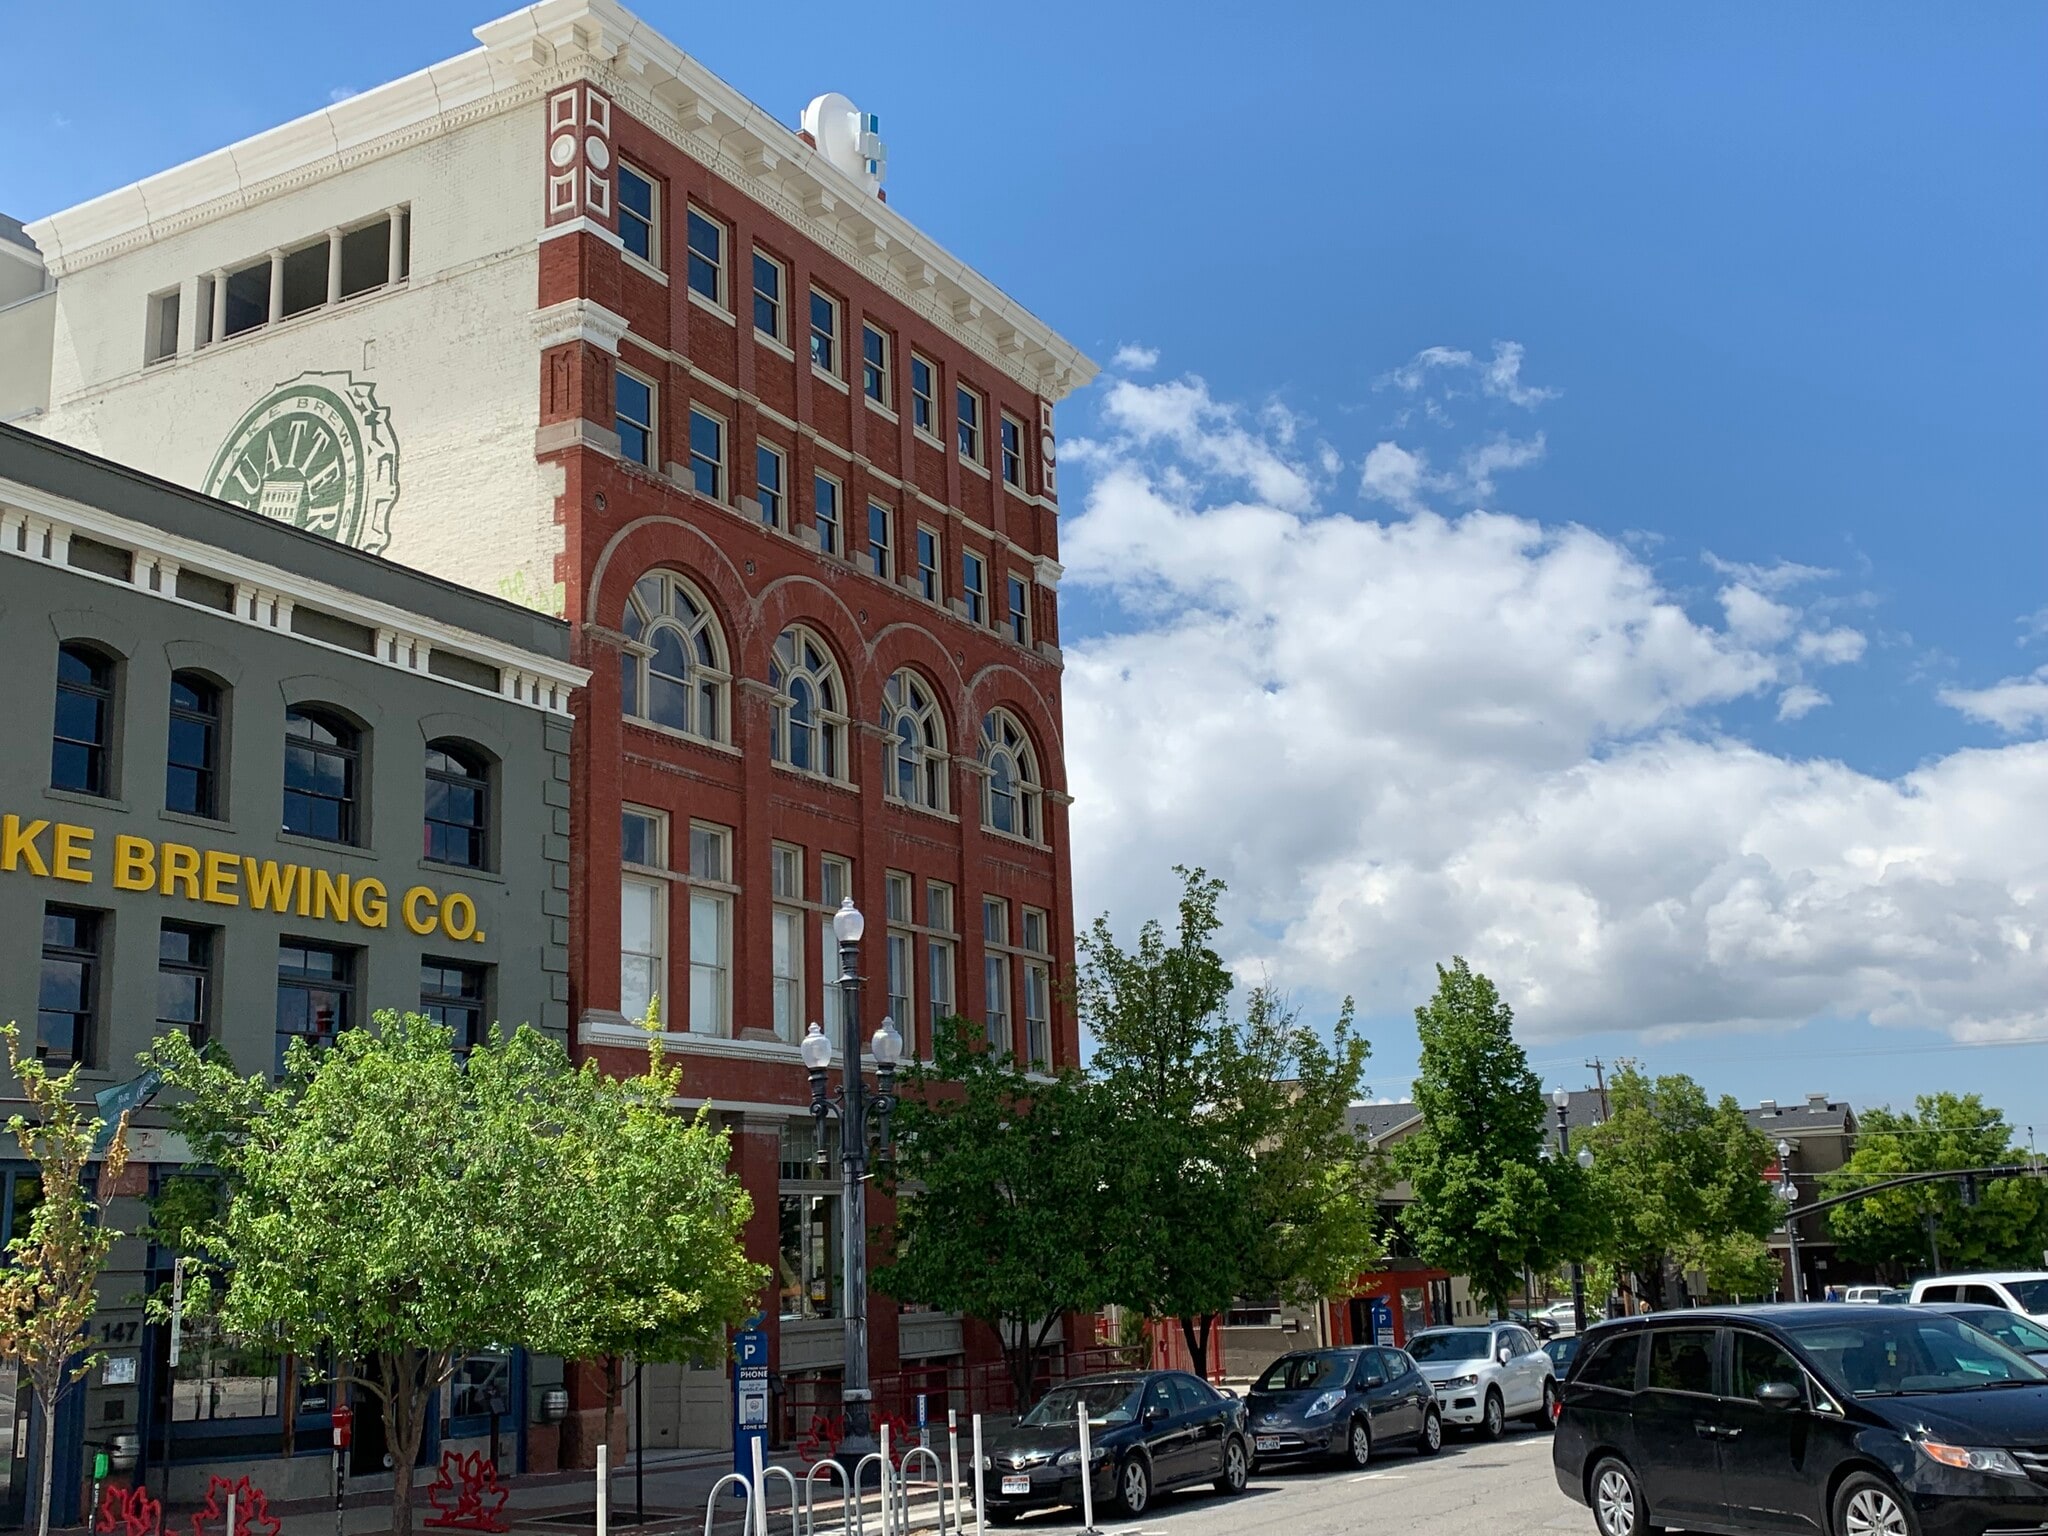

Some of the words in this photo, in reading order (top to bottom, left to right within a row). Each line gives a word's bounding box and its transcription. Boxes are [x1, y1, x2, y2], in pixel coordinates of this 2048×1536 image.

[296, 397, 356, 529] BREWING
[1, 813, 95, 883] KE
[113, 833, 388, 928] BREWING
[403, 885, 486, 943] CO.
[1378, 1313, 1387, 1325] P
[101, 1321, 139, 1343] 147
[744, 1344, 756, 1360] P
